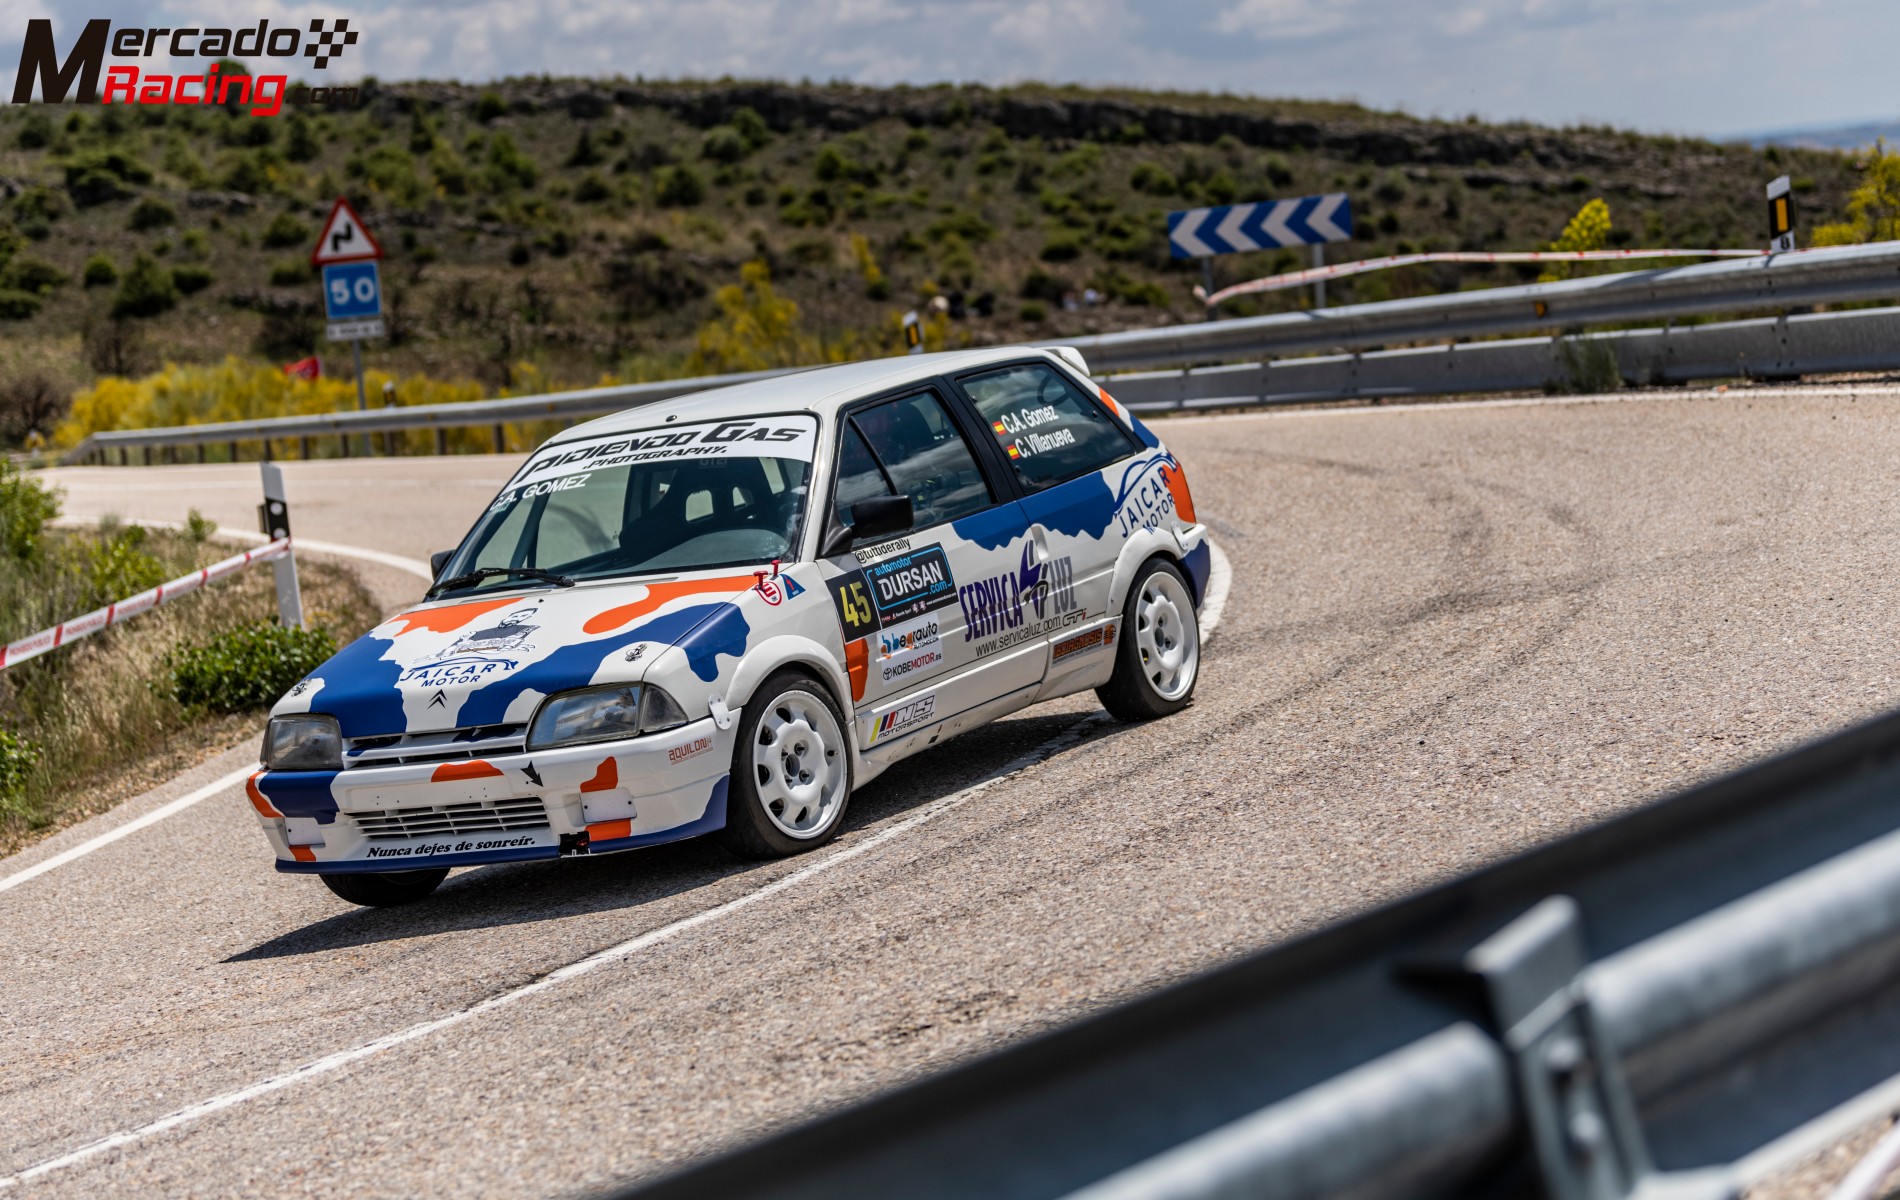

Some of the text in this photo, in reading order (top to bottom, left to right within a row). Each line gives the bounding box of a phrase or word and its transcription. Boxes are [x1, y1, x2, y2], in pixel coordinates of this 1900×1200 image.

[330, 276, 375, 305] 50
[1021, 405, 1059, 427] Gomez
[1015, 428, 1076, 458] C. Villanueva
[521, 473, 592, 499] GOMEZ
[1117, 466, 1171, 538] JAICAR
[1142, 493, 1176, 535] MOTOR
[874, 556, 912, 576] automotor
[877, 560, 944, 600] DURSAN
[929, 580, 948, 595] .com
[959, 556, 1078, 642] SERVICA LUZ
[839, 581, 872, 628] 45
[976, 616, 1060, 657] www.servicaluz.com
[400, 662, 497, 682] JAICAR
[421, 674, 481, 688] MOTOR
[877, 711, 935, 740] MOTORSPORT
[366, 846, 411, 858] Nunca
[414, 843, 451, 856] dejes
[455, 840, 473, 852] de
